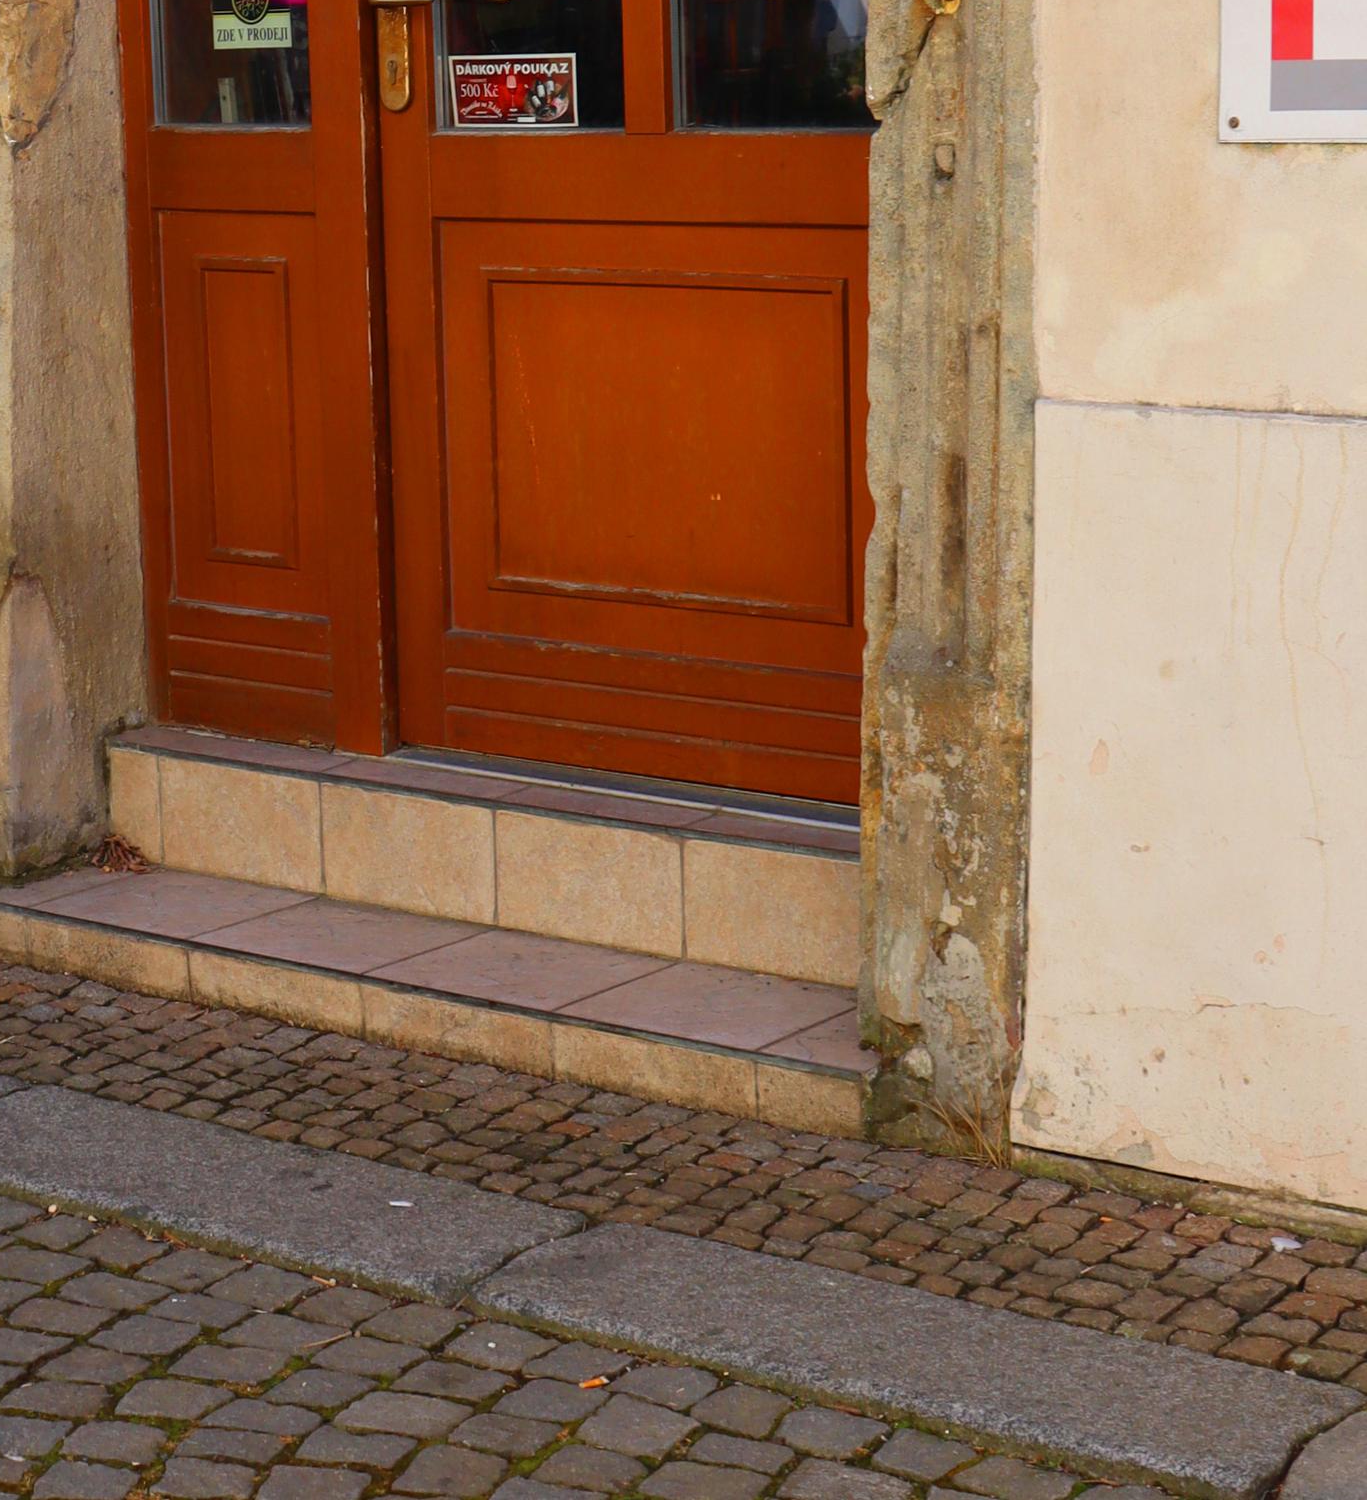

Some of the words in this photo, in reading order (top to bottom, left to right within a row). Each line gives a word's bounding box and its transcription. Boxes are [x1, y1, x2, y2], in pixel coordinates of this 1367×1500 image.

[216, 28, 236, 43] ZDE
[238, 28, 245, 40] V
[247, 26, 289, 42] PRODEJI
[455, 61, 512, 76] DÁRKOVÝ
[513, 62, 569, 75] POUKAZ
[460, 83, 481, 98] 500
[483, 83, 499, 98] Kč
